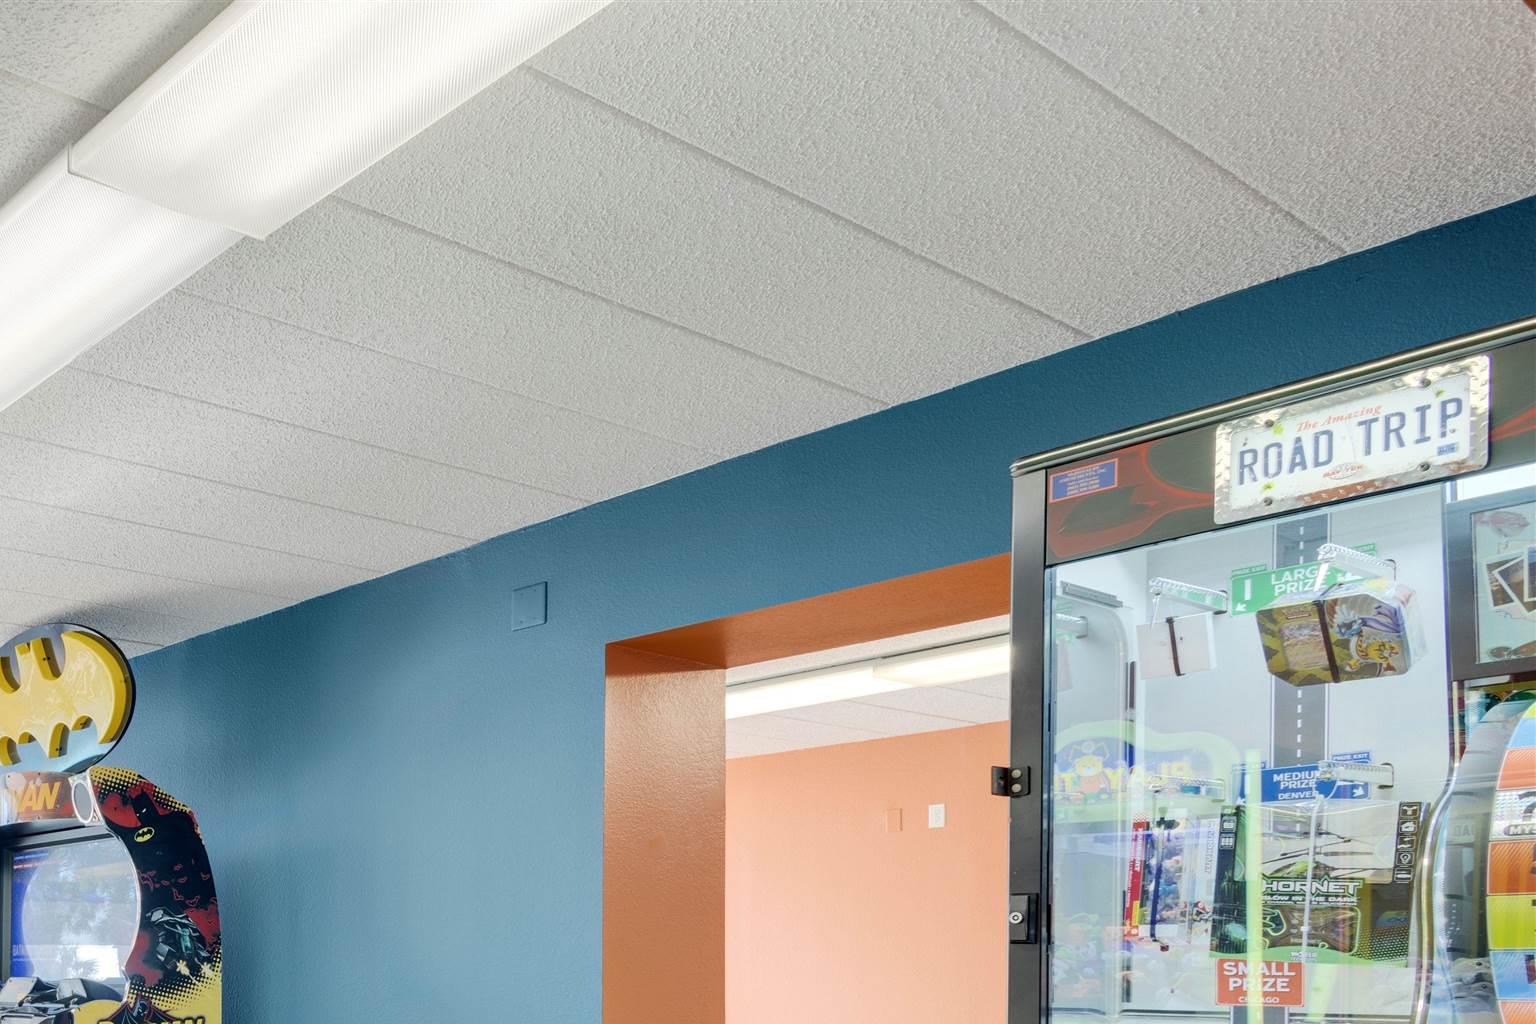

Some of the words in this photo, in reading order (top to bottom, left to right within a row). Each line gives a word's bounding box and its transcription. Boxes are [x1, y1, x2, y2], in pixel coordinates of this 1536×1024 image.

[1238, 428, 1334, 486] ROAD
[1357, 397, 1463, 456] TRIP
[1261, 879, 1360, 896] HORNET
